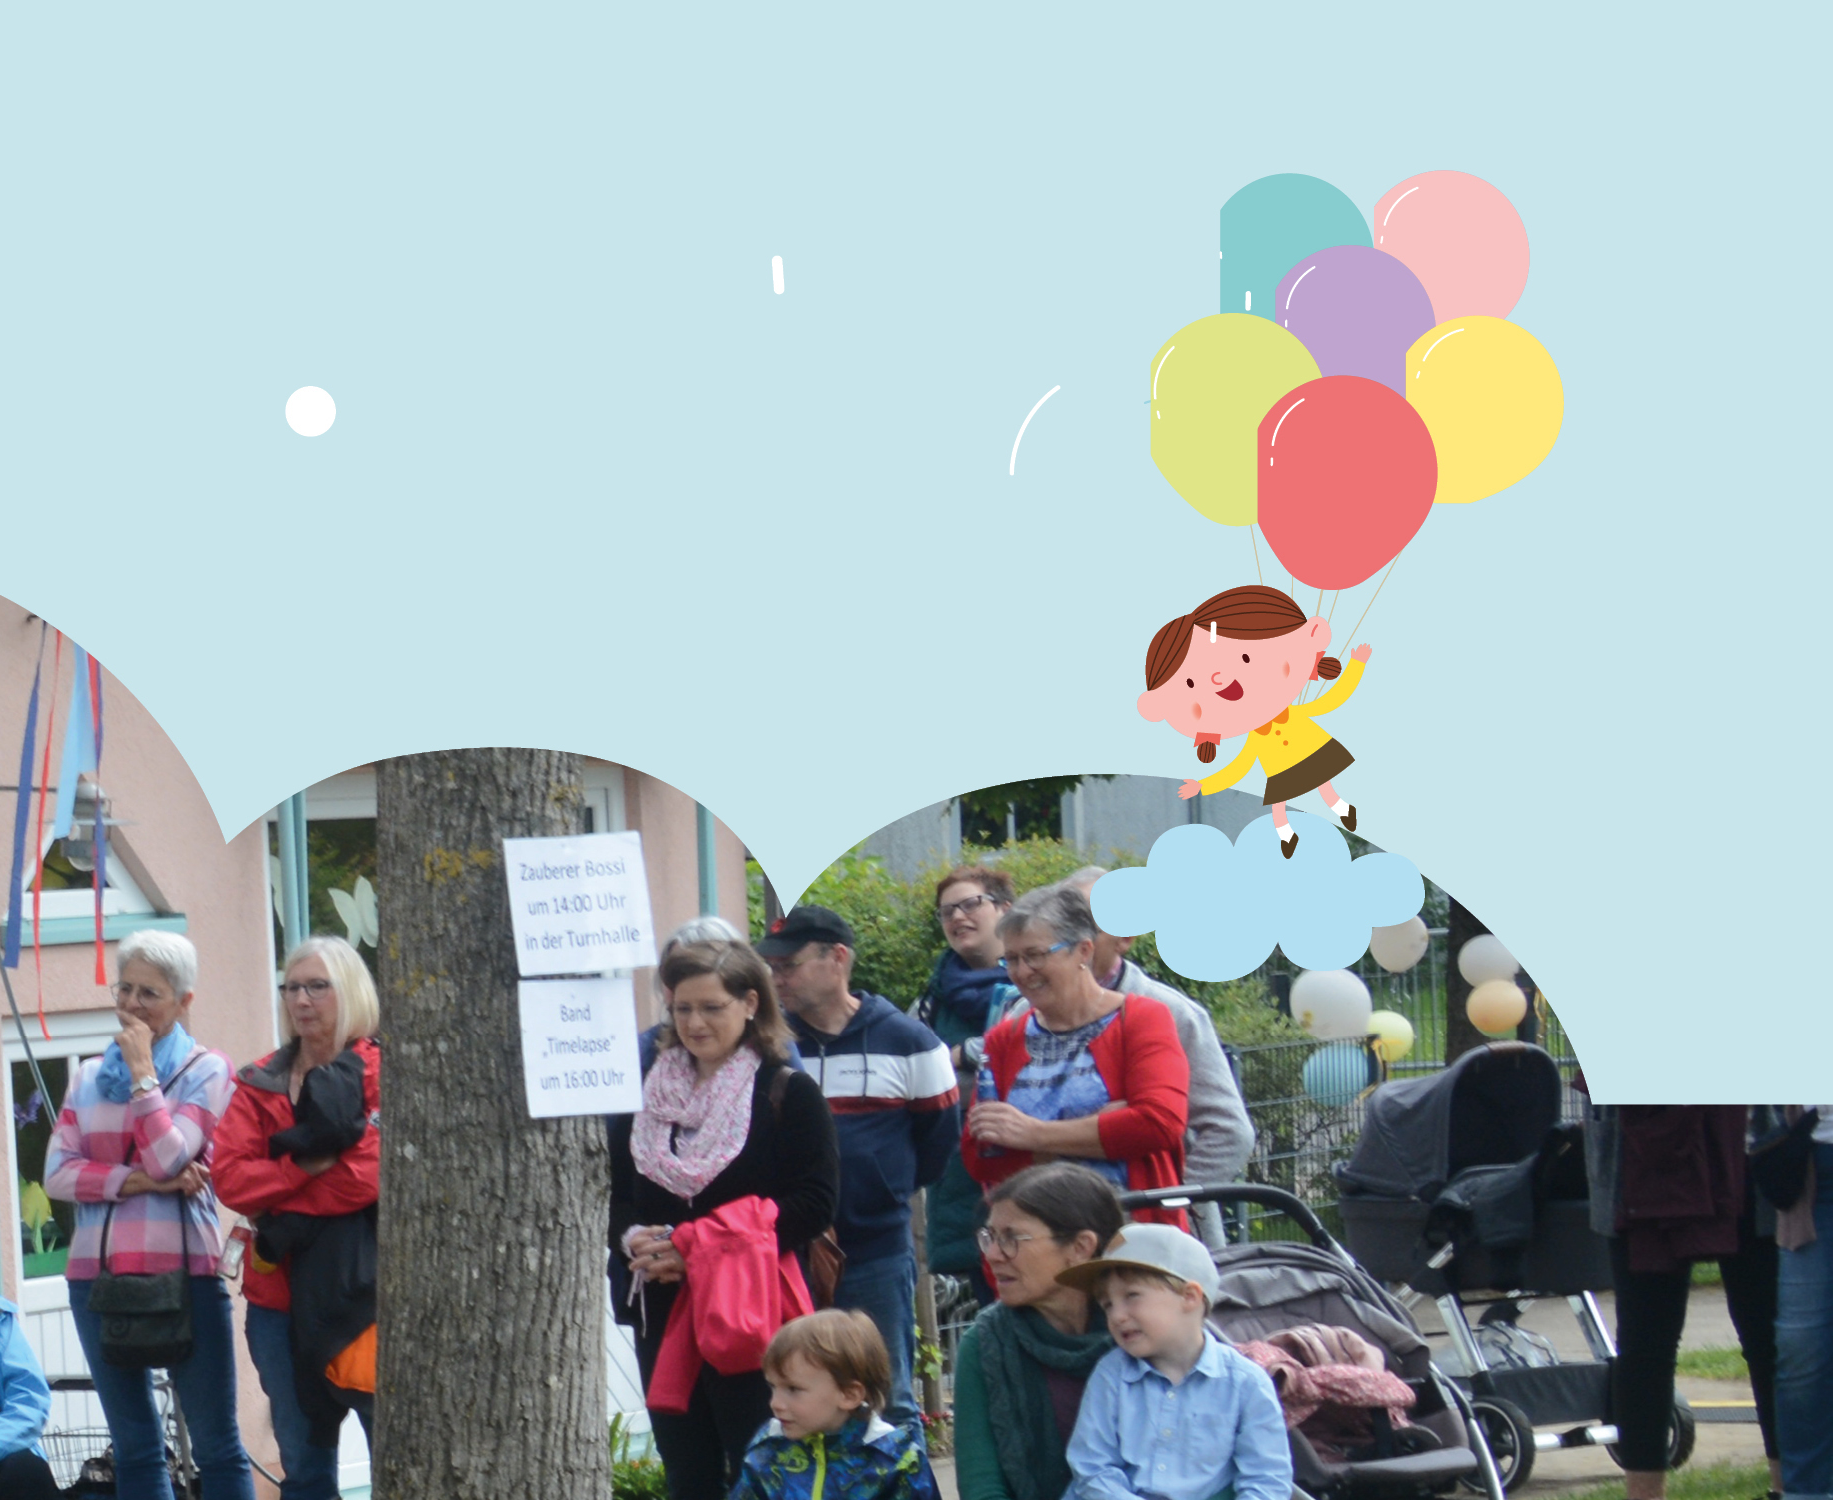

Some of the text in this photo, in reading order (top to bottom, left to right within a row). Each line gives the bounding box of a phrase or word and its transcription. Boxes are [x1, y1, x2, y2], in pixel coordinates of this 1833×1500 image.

[519, 857, 627, 881] Zauberer Bossi
[527, 892, 627, 916] um 14:00 Uhr
[524, 925, 641, 951] in der Turnhalle
[560, 1003, 591, 1022] Band
[540, 1067, 625, 1090] um 16:00 Uhr
